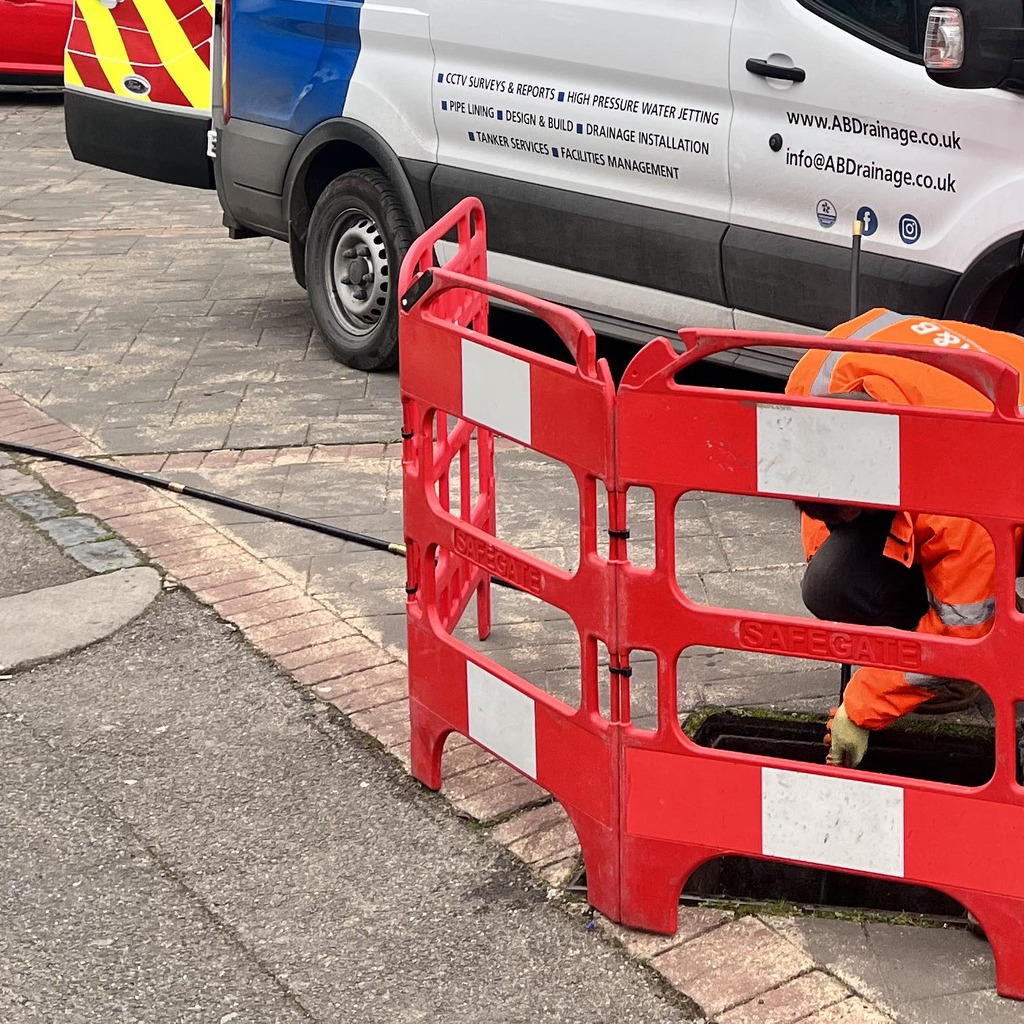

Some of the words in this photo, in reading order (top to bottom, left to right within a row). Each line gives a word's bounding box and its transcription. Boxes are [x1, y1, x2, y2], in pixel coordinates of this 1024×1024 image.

[446, 73, 467, 87] CCTV
[468, 76, 506, 93] SURVEYS
[507, 82, 515, 94] &
[516, 83, 556, 101] REPORTS
[449, 100, 466, 114] PIPE
[467, 103, 495, 119] LINING
[505, 110, 537, 127] DESIGN
[539, 116, 546, 128] &
[548, 117, 574, 132] BUILD
[567, 91, 590, 106] HIGH
[592, 95, 639, 114] PRESSURE
[642, 102, 676, 119] WATER
[678, 107, 719, 126] JETTING
[476, 131, 509, 148] TANKER
[511, 138, 549, 155] SERVICES
[586, 123, 636, 143] DRAINAGE
[638, 131, 709, 155] INSTALLATION
[786, 111, 962, 150] www.ABDrainage.co.uk
[560, 147, 605, 167] FACILITIES
[607, 154, 679, 180] MANAGEMENT
[785, 148, 956, 193] info@ABDrainage.co.uk
[910, 321, 970, 350] &B
[456, 530, 541, 594] SAFEGATE
[743, 621, 919, 669] SAFEGATE
